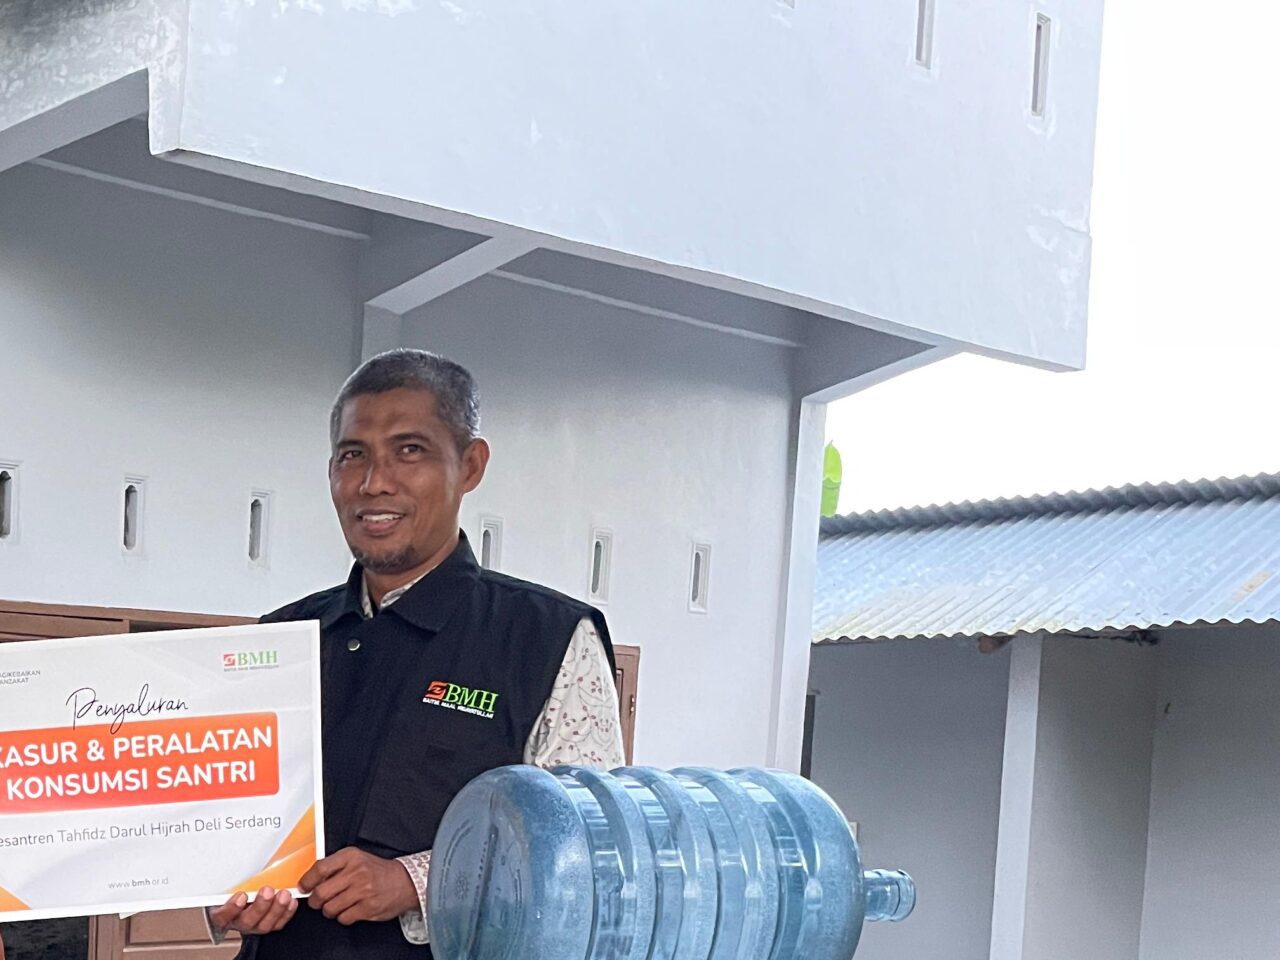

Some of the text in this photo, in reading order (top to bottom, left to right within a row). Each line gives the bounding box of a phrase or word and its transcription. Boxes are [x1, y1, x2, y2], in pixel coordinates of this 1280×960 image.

[237, 650, 277, 666] BMH
[66, 683, 189, 735] Penyaluran
[444, 683, 498, 712] BMH
[86, 739, 106, 762] &
[113, 726, 272, 760] PERALATAN
[6, 760, 256, 801] KONSUMSI SANTRI
[57, 827, 107, 843] Tahfidz
[109, 823, 147, 839] Darul
[151, 820, 191, 838] Hijrah
[194, 817, 221, 832] Deli
[225, 814, 282, 829] Serdang
